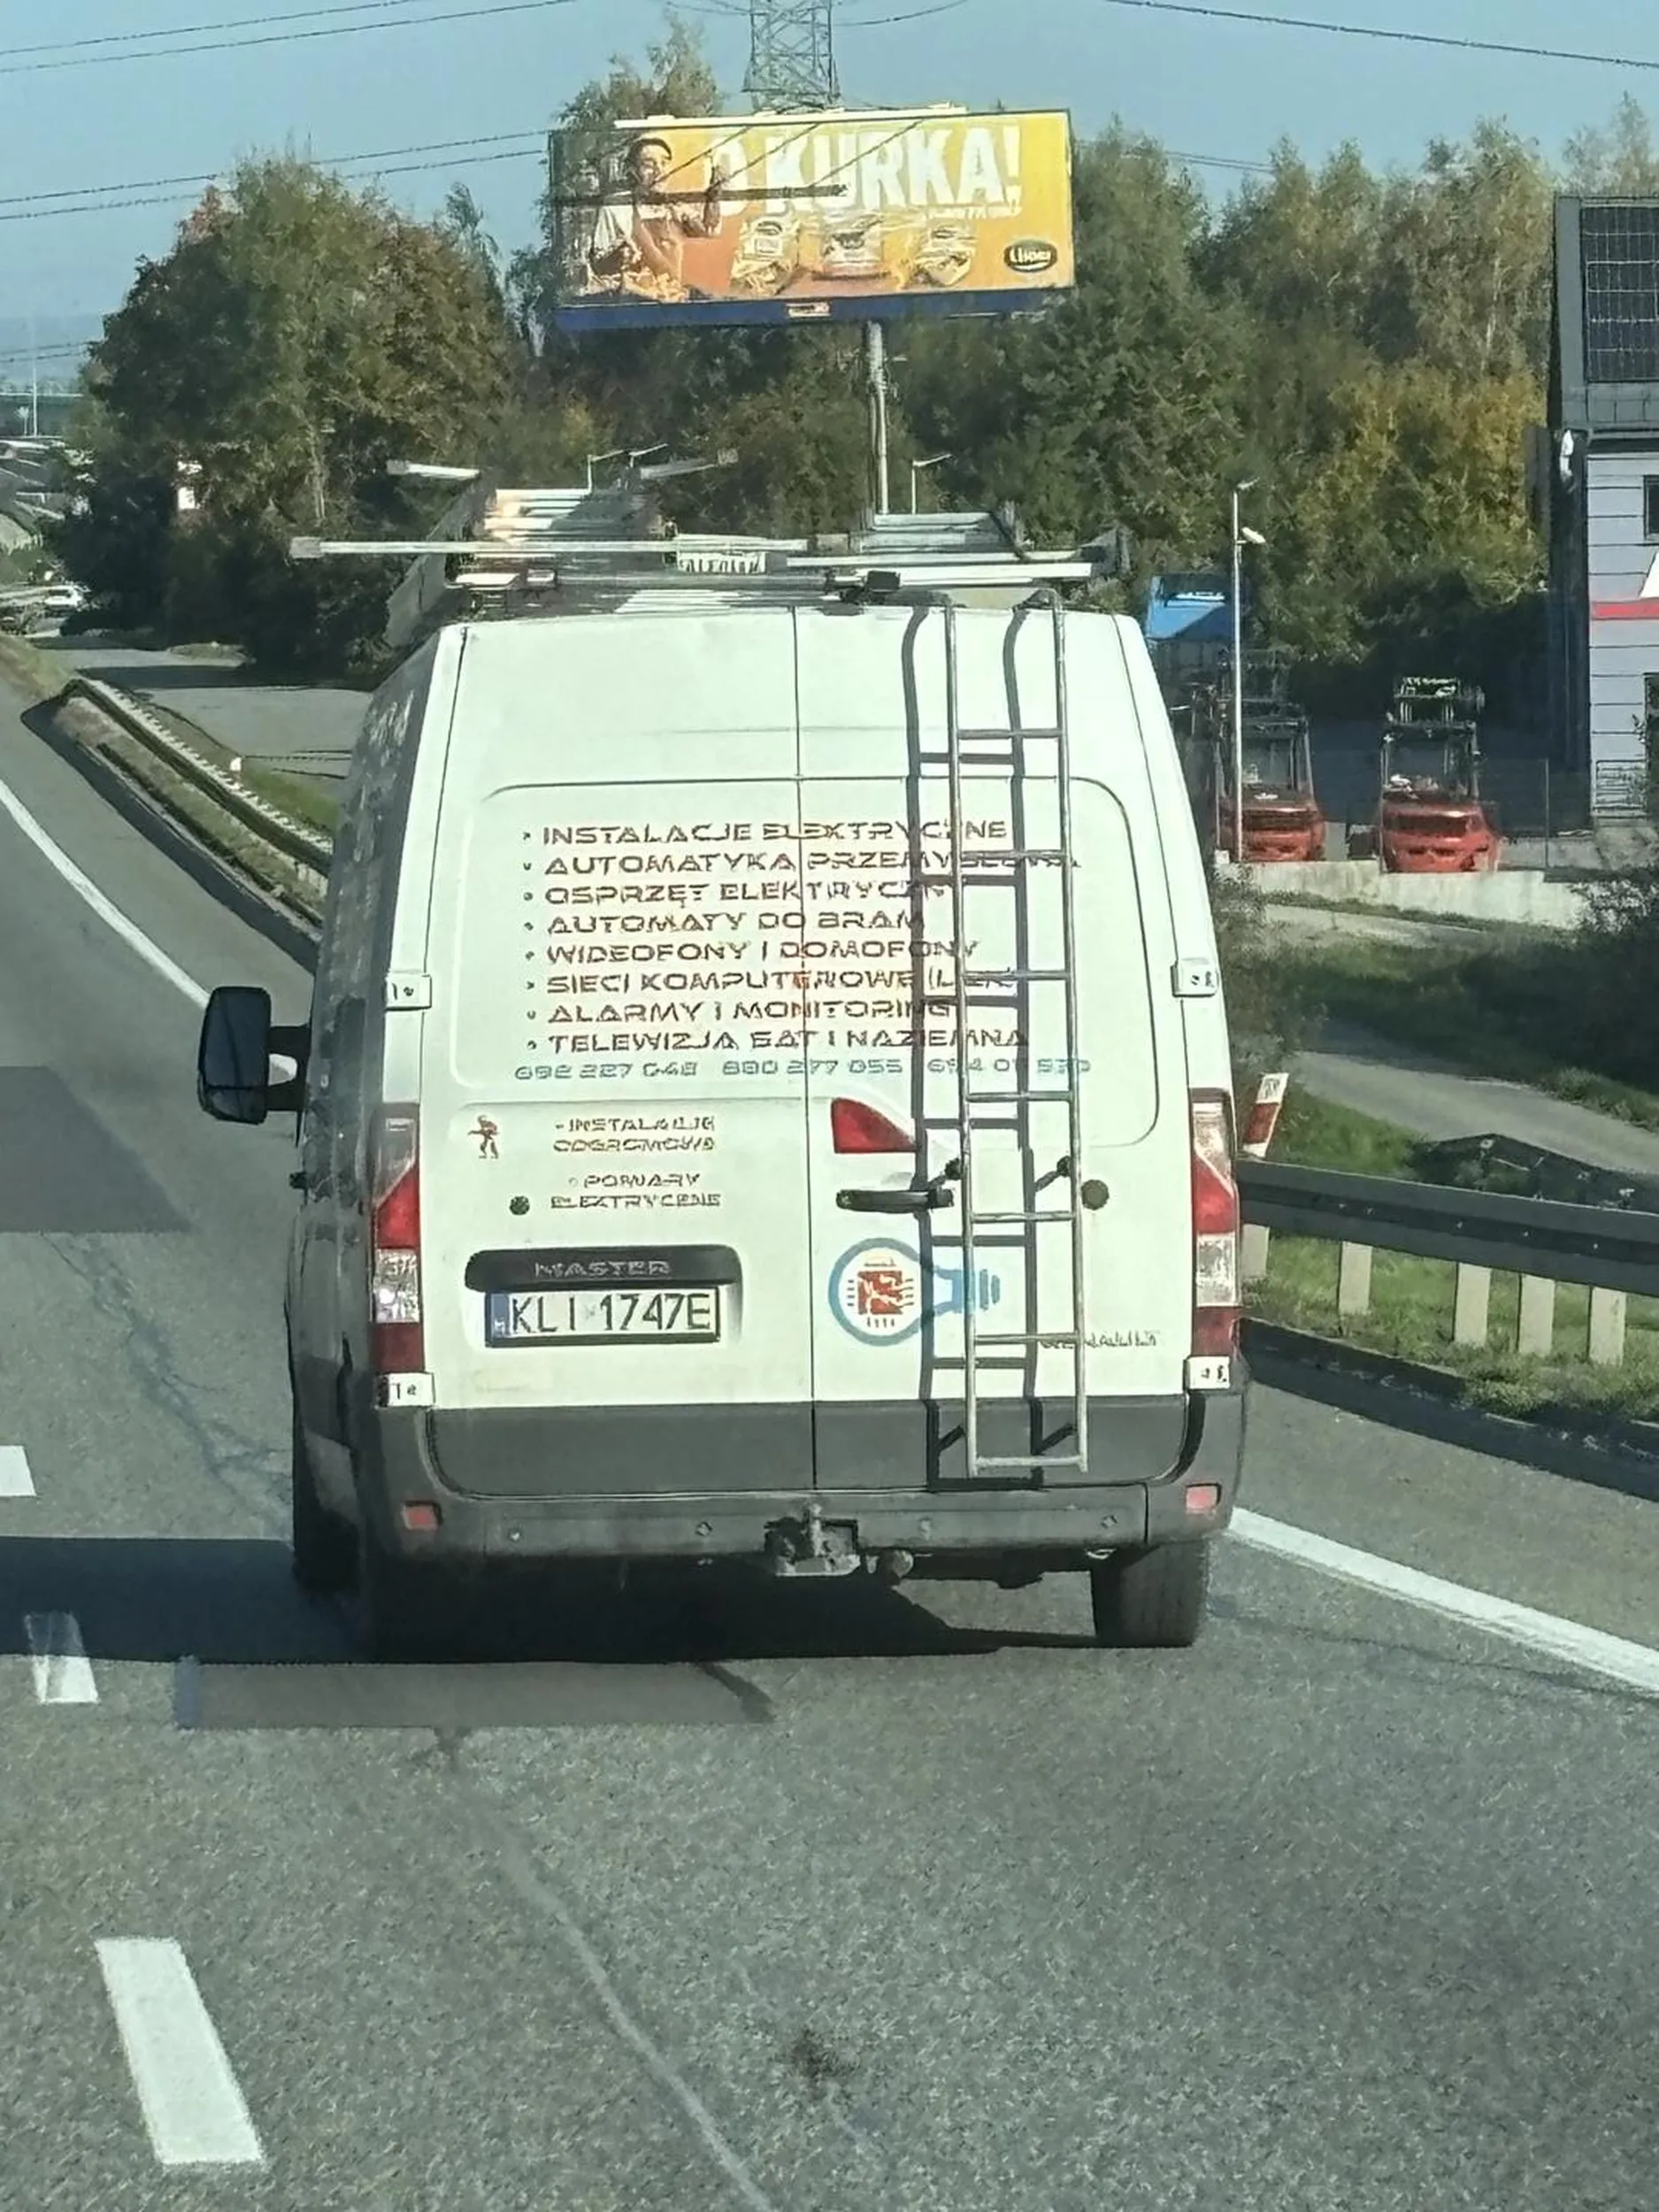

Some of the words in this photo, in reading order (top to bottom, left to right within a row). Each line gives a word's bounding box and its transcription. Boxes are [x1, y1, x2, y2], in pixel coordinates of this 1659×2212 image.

[764, 125, 1022, 213] KURKA!
[543, 823, 751, 845] INSTALACJE
[545, 852, 796, 875] AUTOMATYKA
[545, 883, 710, 908] OSPRZĘT
[548, 912, 746, 933] AUTOMATY
[758, 912, 805, 930] DO
[818, 910, 924, 930] BRAM
[547, 941, 749, 964] WIDEOFONY
[761, 941, 768, 961] I
[780, 940, 980, 959] DOMOFONY
[547, 973, 630, 995] SIECI
[641, 970, 917, 991] KOMPUTEROWE
[548, 1002, 704, 1024] ALARMY
[715, 1001, 722, 1021] I
[733, 1001, 950, 1019] MONITORING
[549, 1030, 740, 1053] TELEWIZJA
[750, 1030, 819, 1049] SAT
[828, 1030, 835, 1046] I
[847, 1029, 1029, 1048] NAZIEMNA
[534, 1260, 672, 1277] MASTER
[512, 1295, 576, 1333] KLI
[599, 1294, 710, 1332] 1747E
